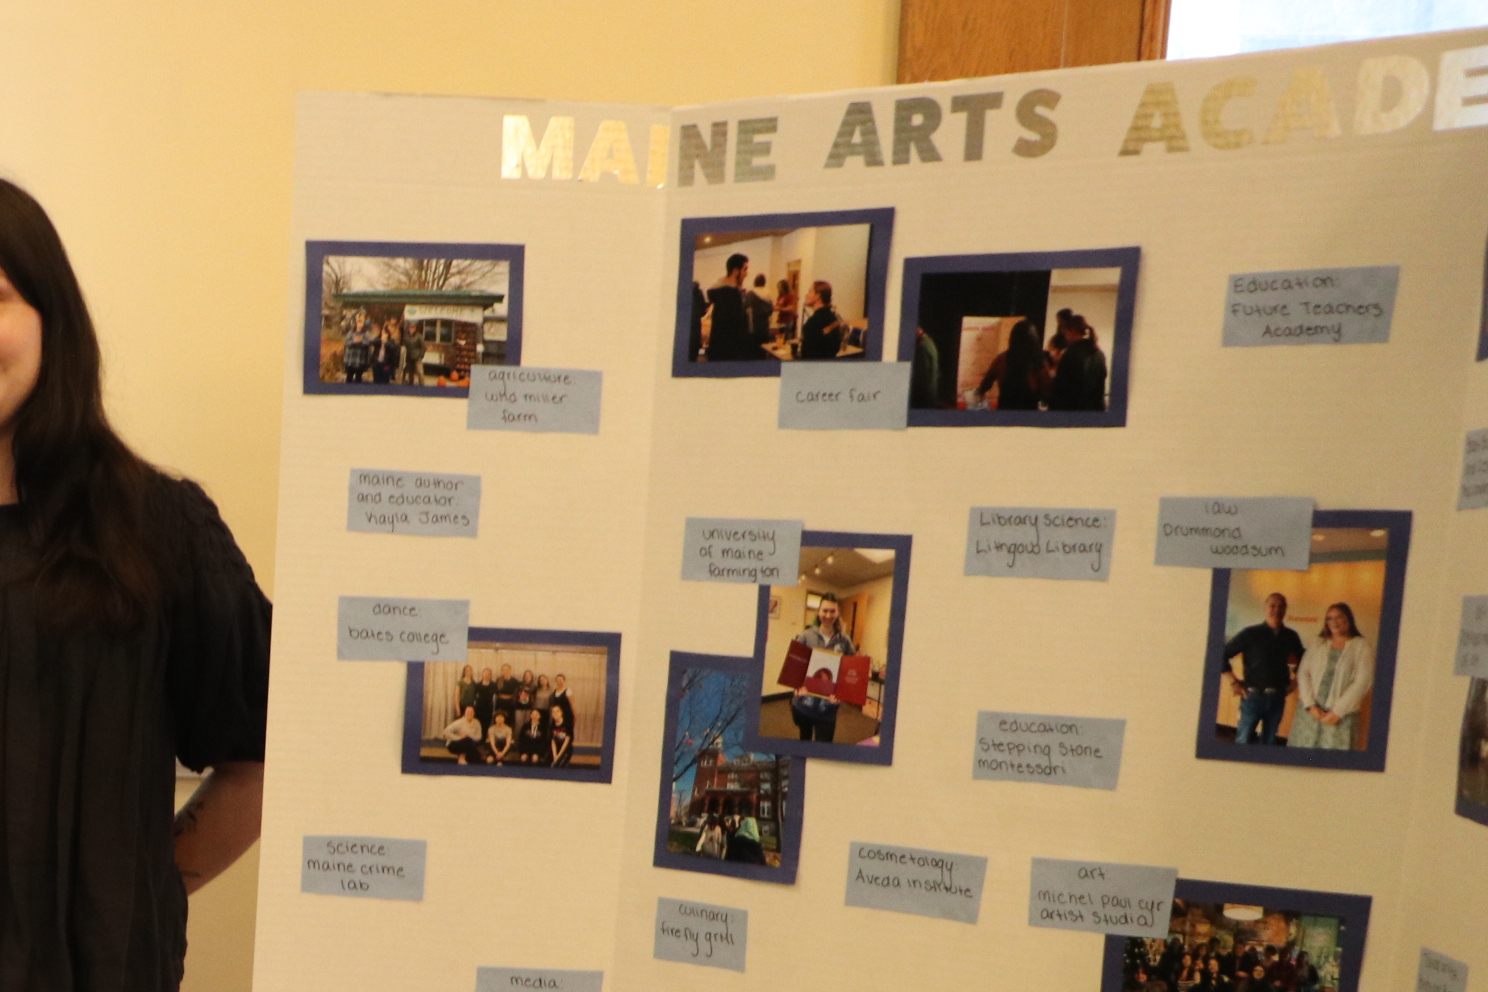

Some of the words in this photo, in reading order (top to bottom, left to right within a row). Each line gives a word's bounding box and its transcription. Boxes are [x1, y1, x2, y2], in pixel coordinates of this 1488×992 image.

[501, 114, 778, 188] MAINE
[823, 88, 1061, 168] ARTS
[1301, 301, 1384, 318] Teachers
[1262, 322, 1343, 343] Academy
[849, 388, 882, 403] fair
[502, 409, 538, 423] farm
[359, 473, 405, 488] maine
[415, 477, 464, 491] author
[357, 492, 382, 504] and
[418, 511, 470, 526] James
[980, 512, 1040, 544] Library
[702, 529, 776, 555] university
[699, 545, 713, 558] of
[721, 548, 763, 560] maine
[1046, 540, 1103, 572] Library
[348, 625, 394, 642] bates
[400, 630, 449, 655] college
[307, 859, 355, 873] maine
[360, 864, 406, 878] crime
[340, 879, 369, 891] lab
[855, 868, 901, 888] Aveda
[1101, 894, 1131, 909] paul
[1040, 908, 1084, 923] artist
